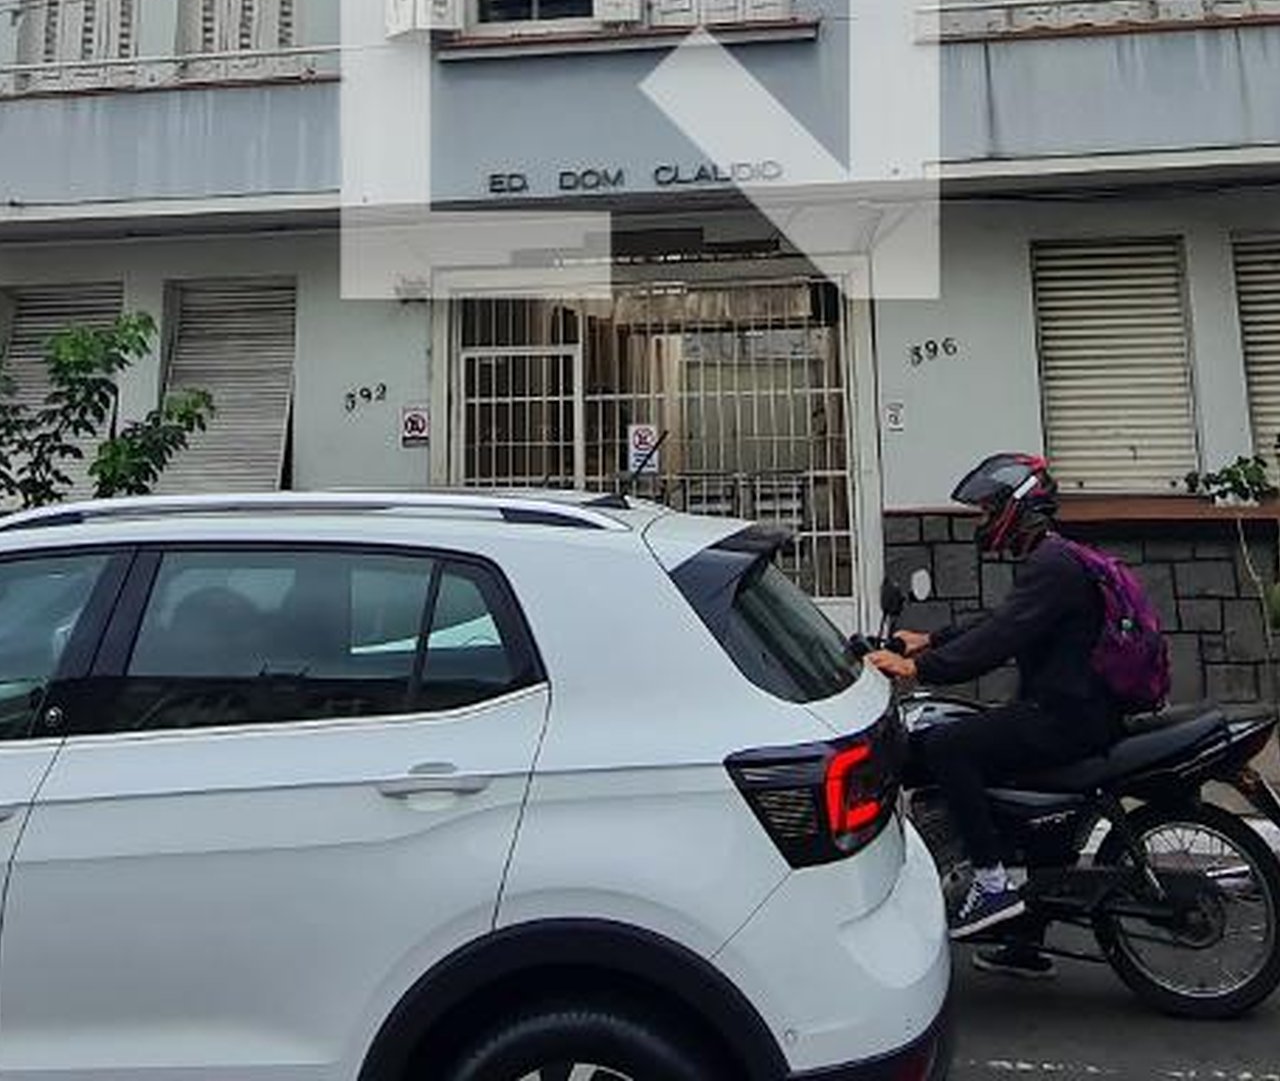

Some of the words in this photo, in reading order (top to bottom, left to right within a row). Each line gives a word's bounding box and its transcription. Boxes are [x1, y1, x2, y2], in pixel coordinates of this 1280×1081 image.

[558, 169, 625, 191] DOM
[654, 160, 783, 185] CLAUDIO
[911, 337, 958, 368] 396
[345, 382, 387, 412] 392
